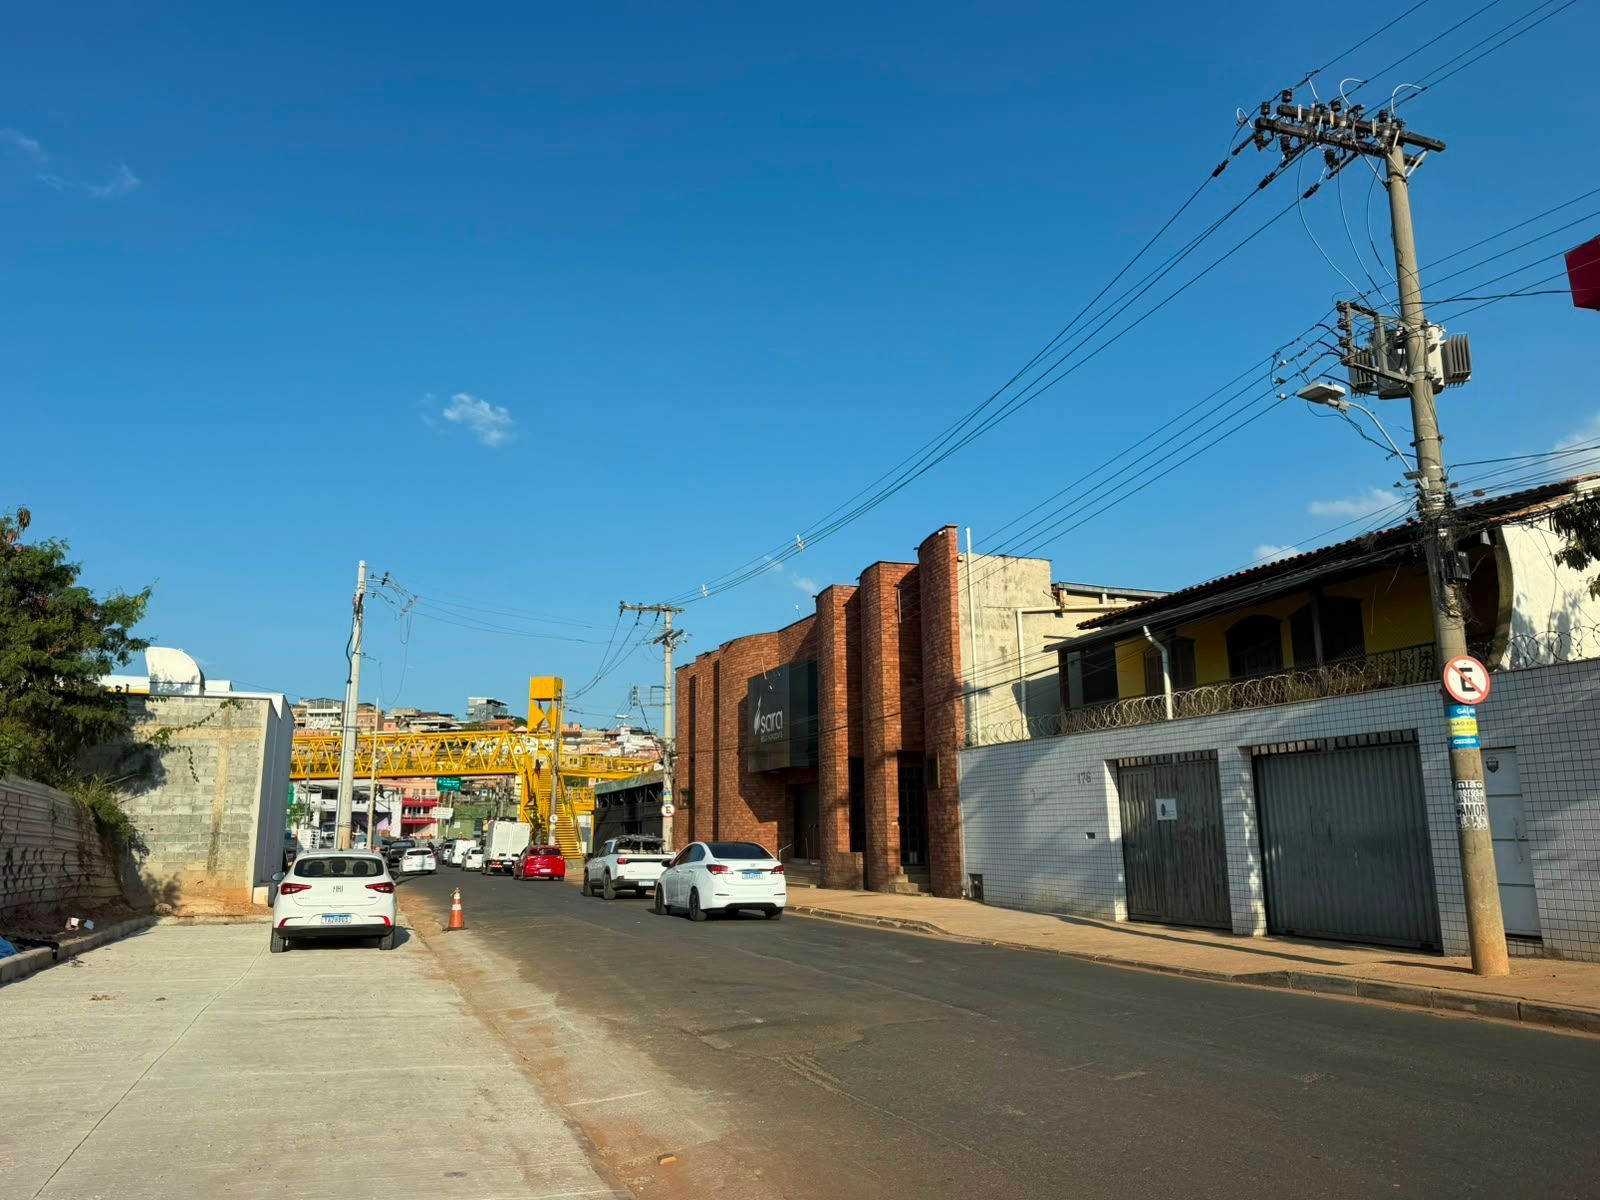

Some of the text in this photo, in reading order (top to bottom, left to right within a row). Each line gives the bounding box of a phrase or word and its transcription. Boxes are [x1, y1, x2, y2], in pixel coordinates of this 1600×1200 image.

[1458, 667, 1476, 692] E
[760, 710, 783, 734] sara
[1078, 771, 1092, 785] 176
[1461, 803, 1485, 817] AMOR
